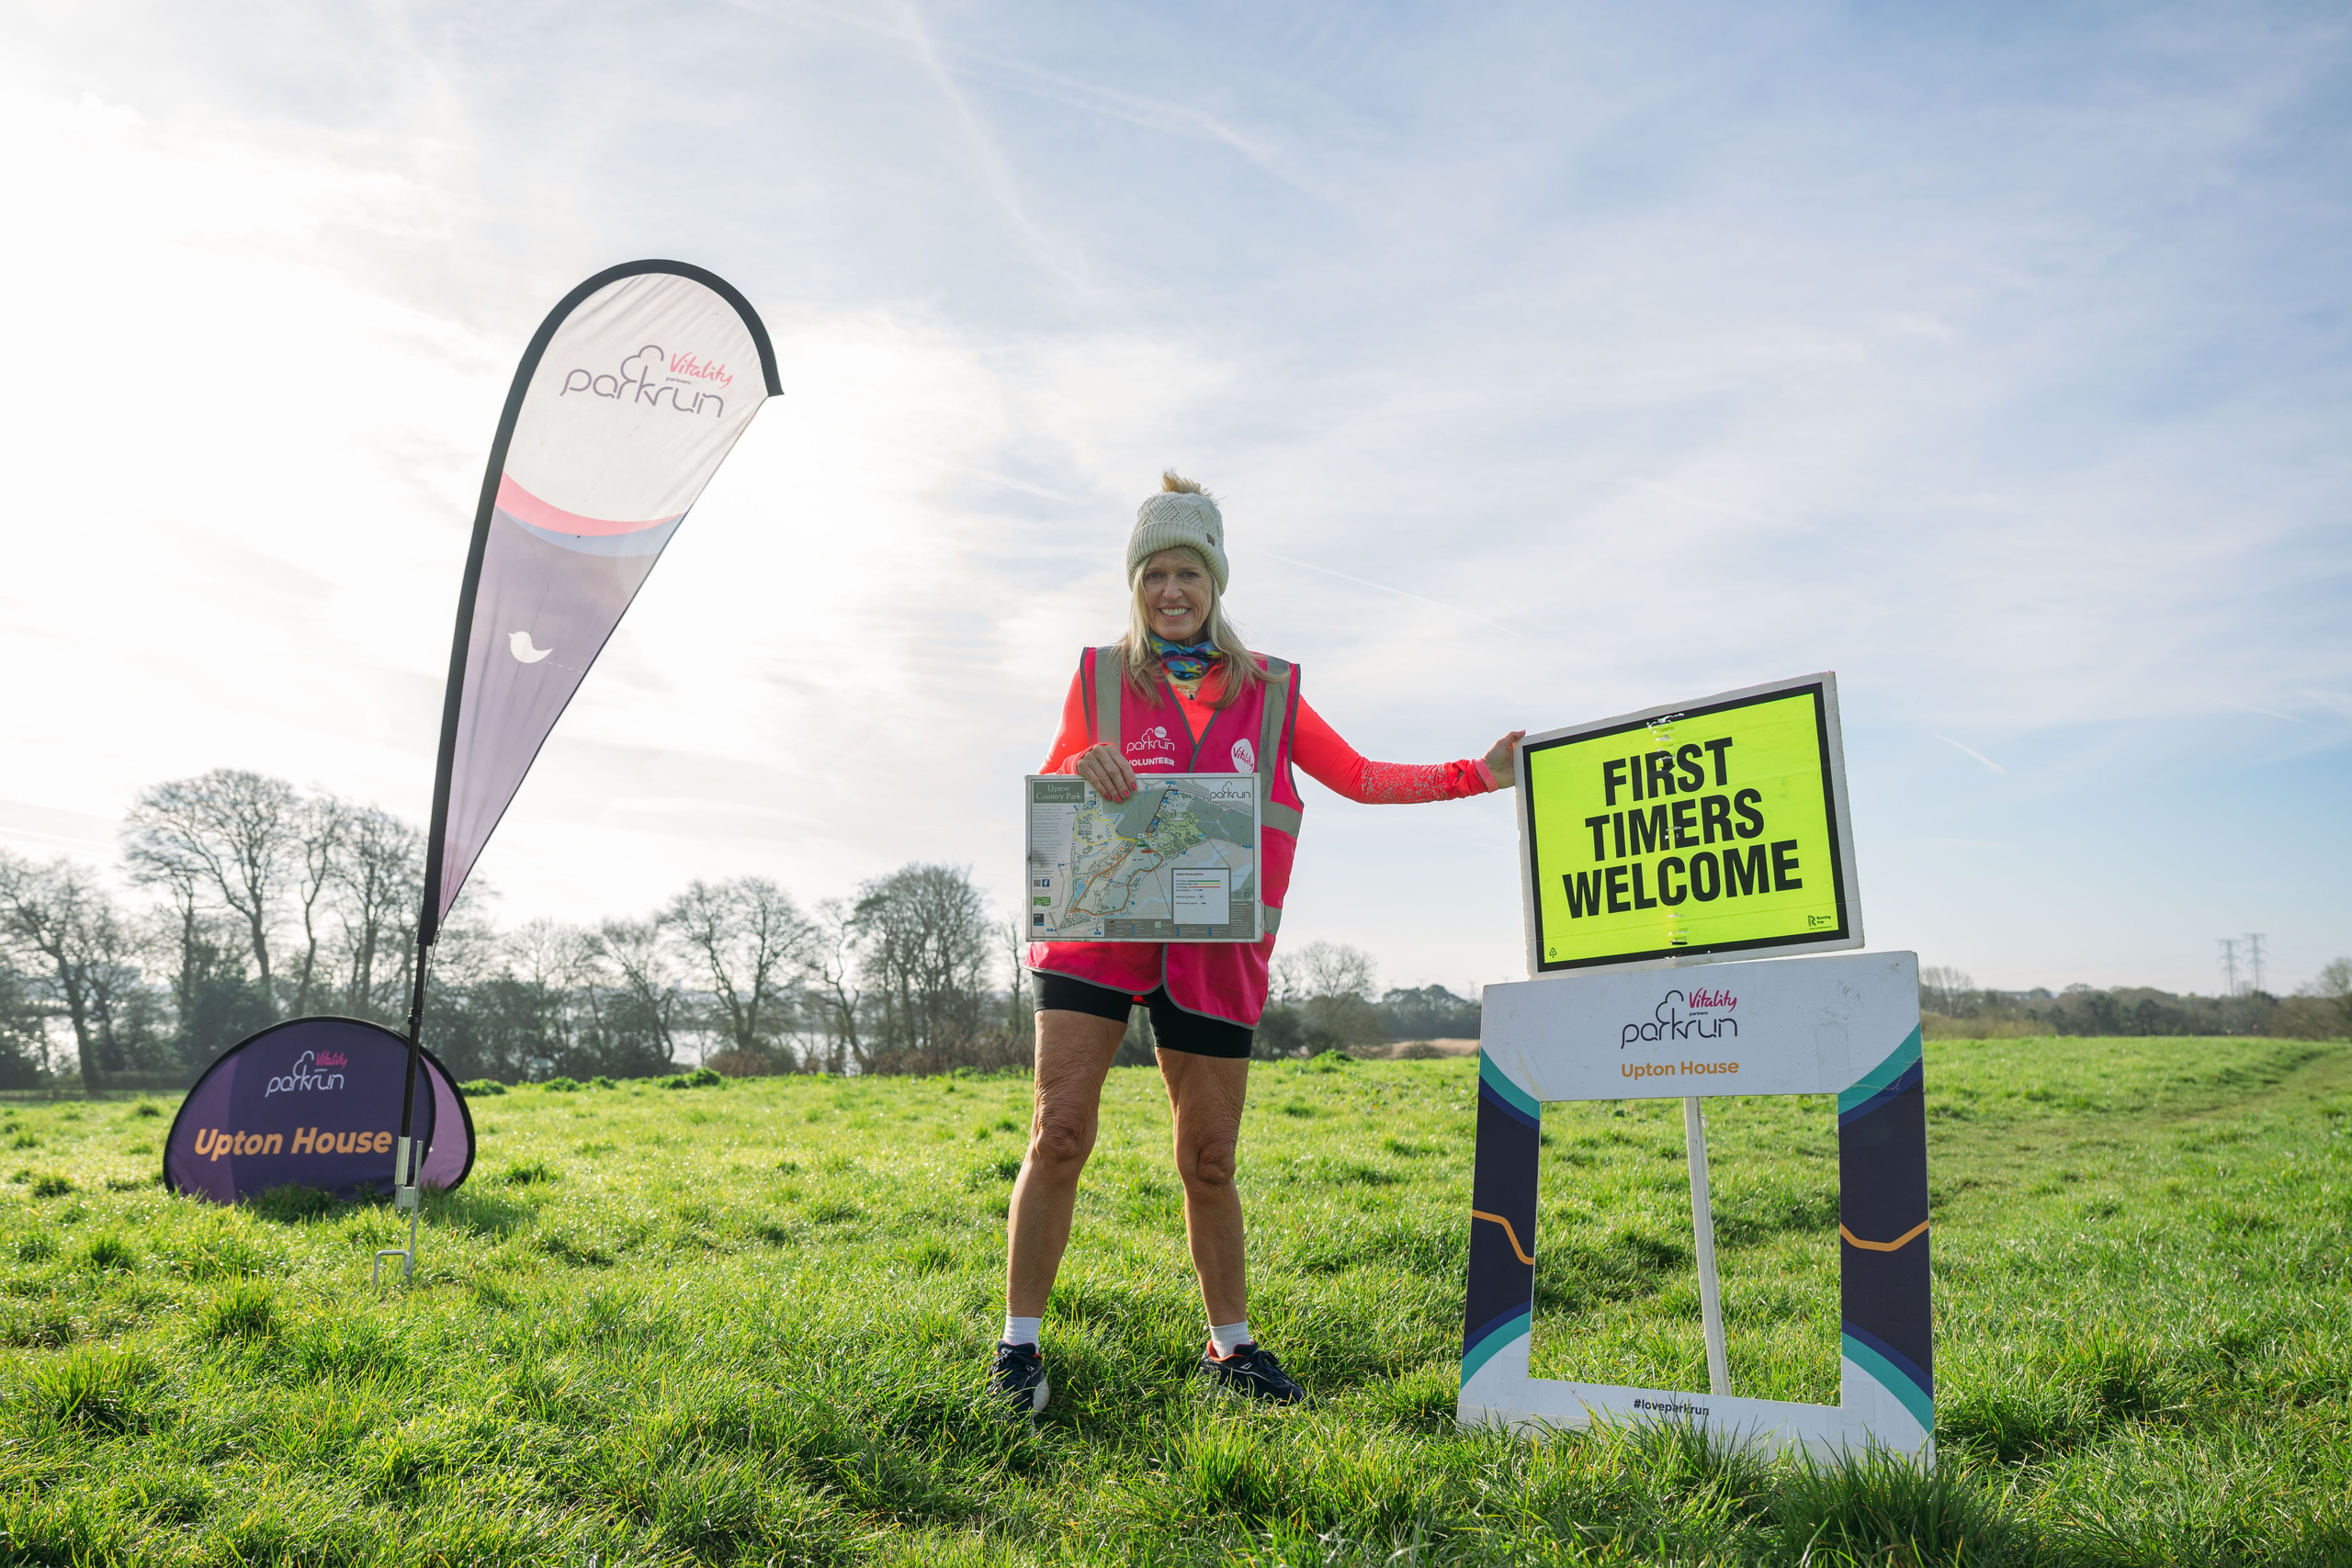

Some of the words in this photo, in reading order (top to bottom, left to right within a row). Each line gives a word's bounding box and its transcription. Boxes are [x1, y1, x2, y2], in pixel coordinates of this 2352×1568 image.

[665, 376, 692, 386] partners
[670, 352, 733, 389] Vitality
[560, 365, 724, 419] parkrun
[1125, 736, 1175, 754] parkrun
[1233, 745, 1254, 771] Vitality
[1602, 737, 1733, 807] FIRST
[1035, 793, 1065, 801] Country
[1066, 792, 1081, 800] Park
[1047, 784, 1070, 793] Upton
[1209, 787, 1250, 801] parkrun
[1585, 788, 1765, 863] TIMERS
[1562, 839, 1804, 919] WELCOME
[1689, 987, 1737, 1013] Vitality
[1620, 1008, 1738, 1050] parkrun
[315, 1049, 348, 1071] Vitality
[1621, 1062, 1676, 1081] Upton
[1680, 1060, 1740, 1076] House
[265, 1065, 345, 1098] parkrun
[194, 1128, 284, 1162] Upton
[290, 1127, 393, 1155] House
[1634, 1398, 1710, 1416] #loveparkrun
